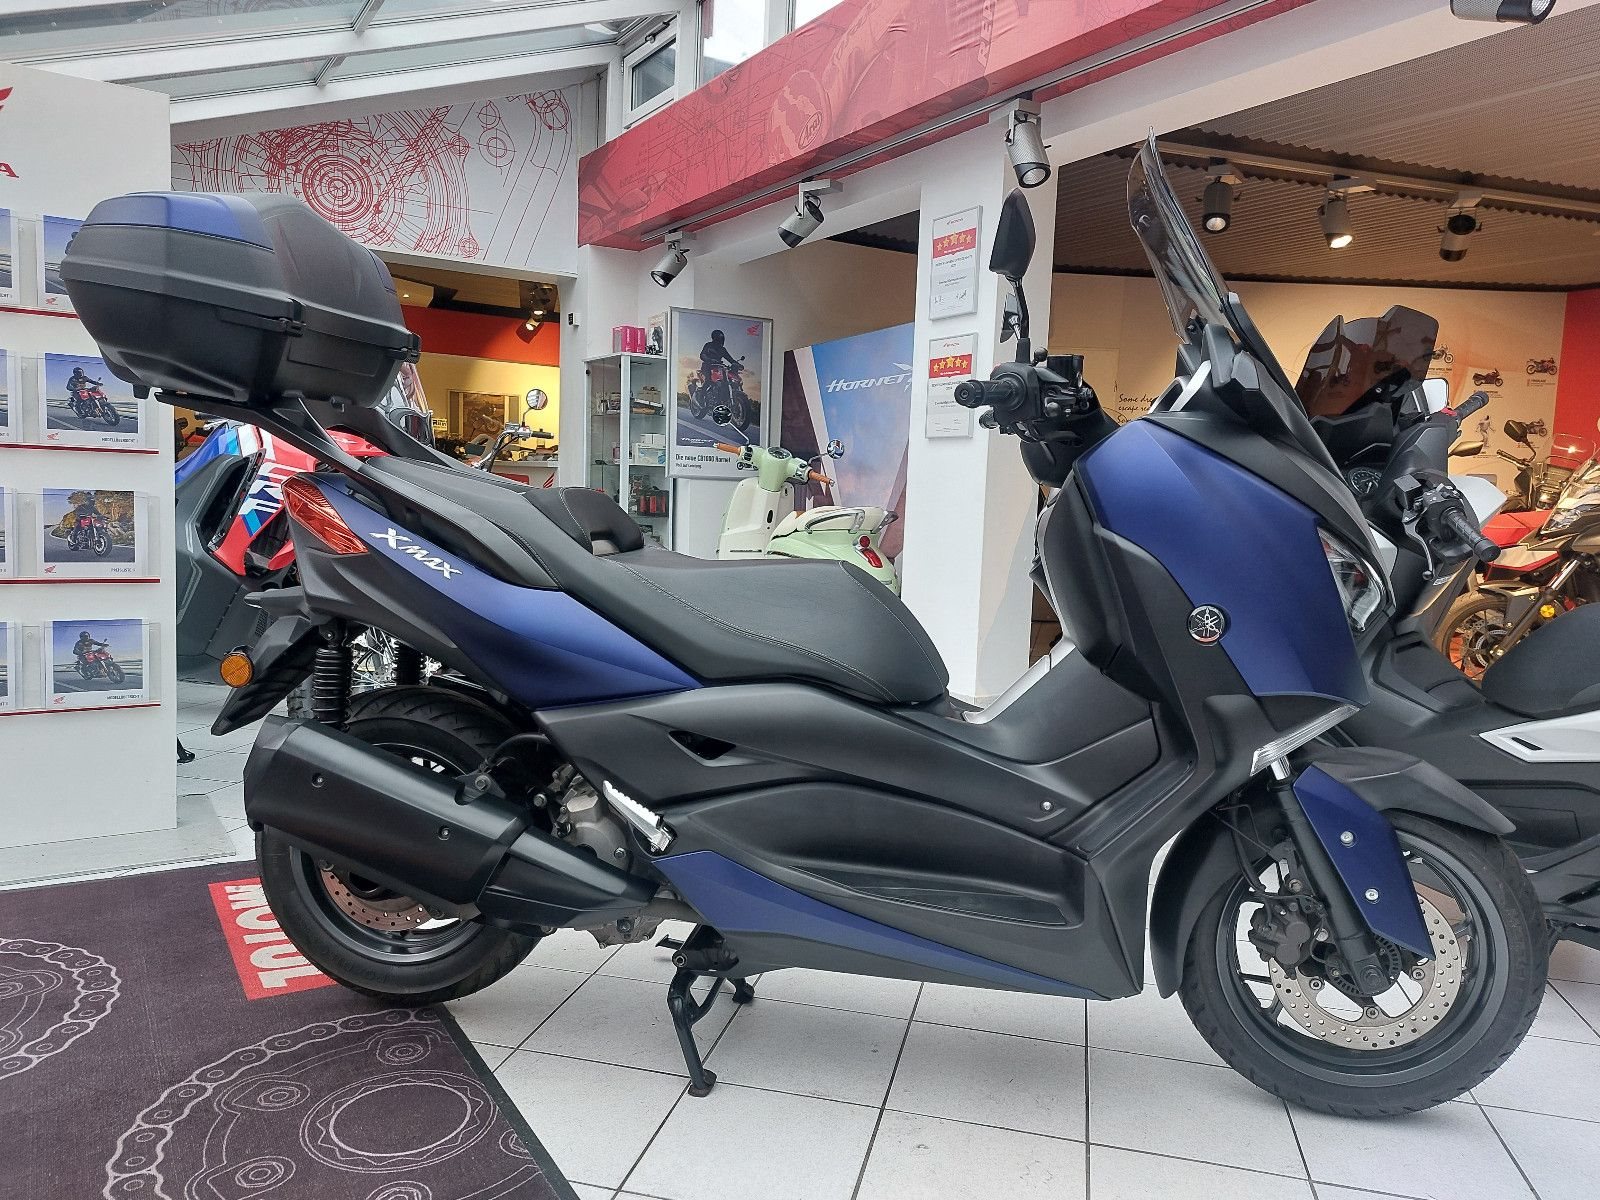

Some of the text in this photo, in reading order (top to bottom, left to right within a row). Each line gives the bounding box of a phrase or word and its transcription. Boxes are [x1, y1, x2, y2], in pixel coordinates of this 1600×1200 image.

[826, 373, 912, 393] HORNET
[1119, 393, 1153, 402] Some dre
[675, 453, 684, 461] Die
